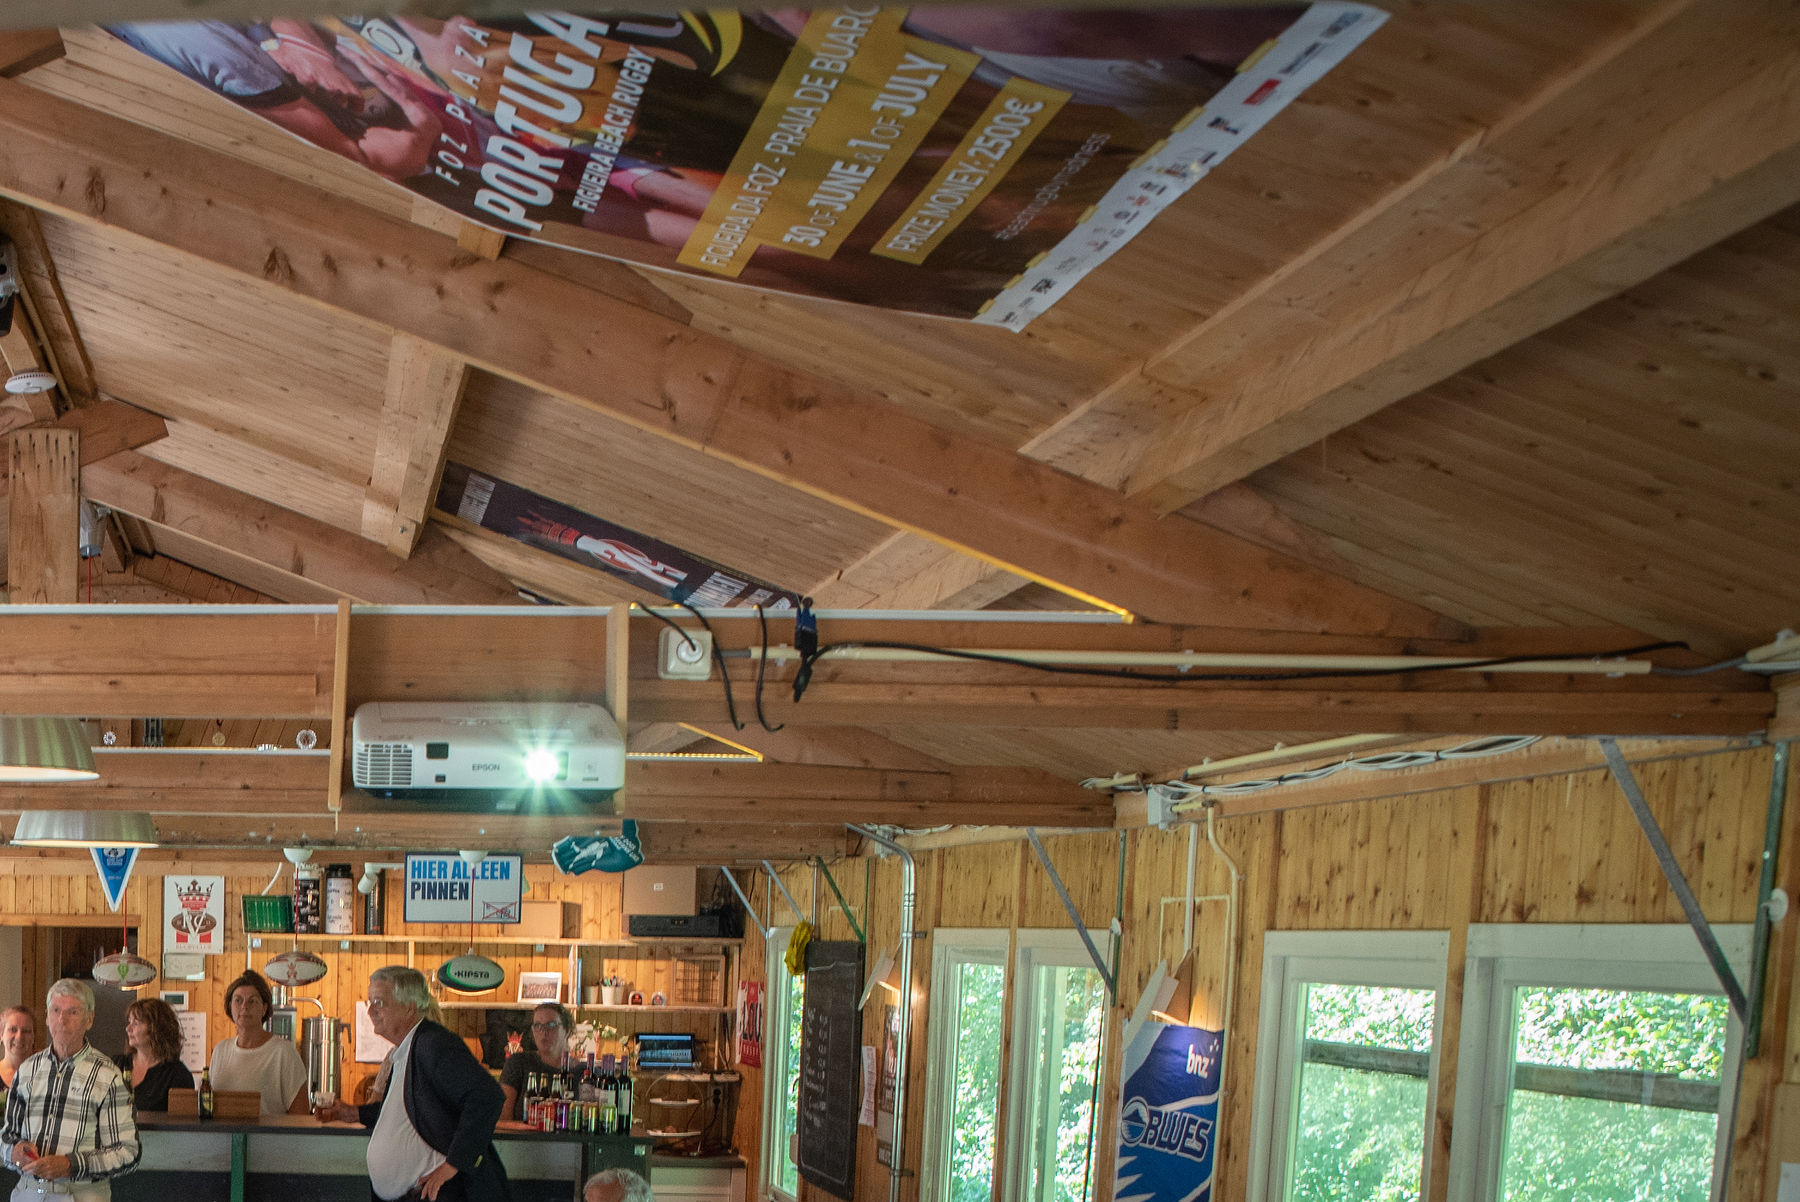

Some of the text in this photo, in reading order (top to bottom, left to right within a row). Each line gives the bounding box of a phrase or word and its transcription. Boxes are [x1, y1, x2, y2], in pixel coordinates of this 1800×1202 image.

[793, 75, 839, 103] DE
[871, 53, 948, 117] JULY
[572, 45, 655, 214] FIGUEIRA BEACH RUGBY
[764, 107, 823, 156] PRAIA
[871, 116, 904, 139] OF
[435, 133, 467, 186] FOZ
[847, 138, 891, 151] 1
[743, 162, 786, 195] FOZ
[807, 161, 876, 212] JUNE
[886, 98, 1044, 253] PRIZE MONEY: 2500€
[731, 195, 768, 223] DA
[810, 211, 838, 228] OF
[701, 215, 752, 267] FIGUEIRA
[782, 226, 827, 248] 30
[472, 763, 500, 772] EPSON
[411, 860, 511, 880] HIER ALLEEN
[410, 881, 469, 900] PINNEN
[1186, 1044, 1209, 1079] bnz
[1142, 1106, 1215, 1164] BLUES
